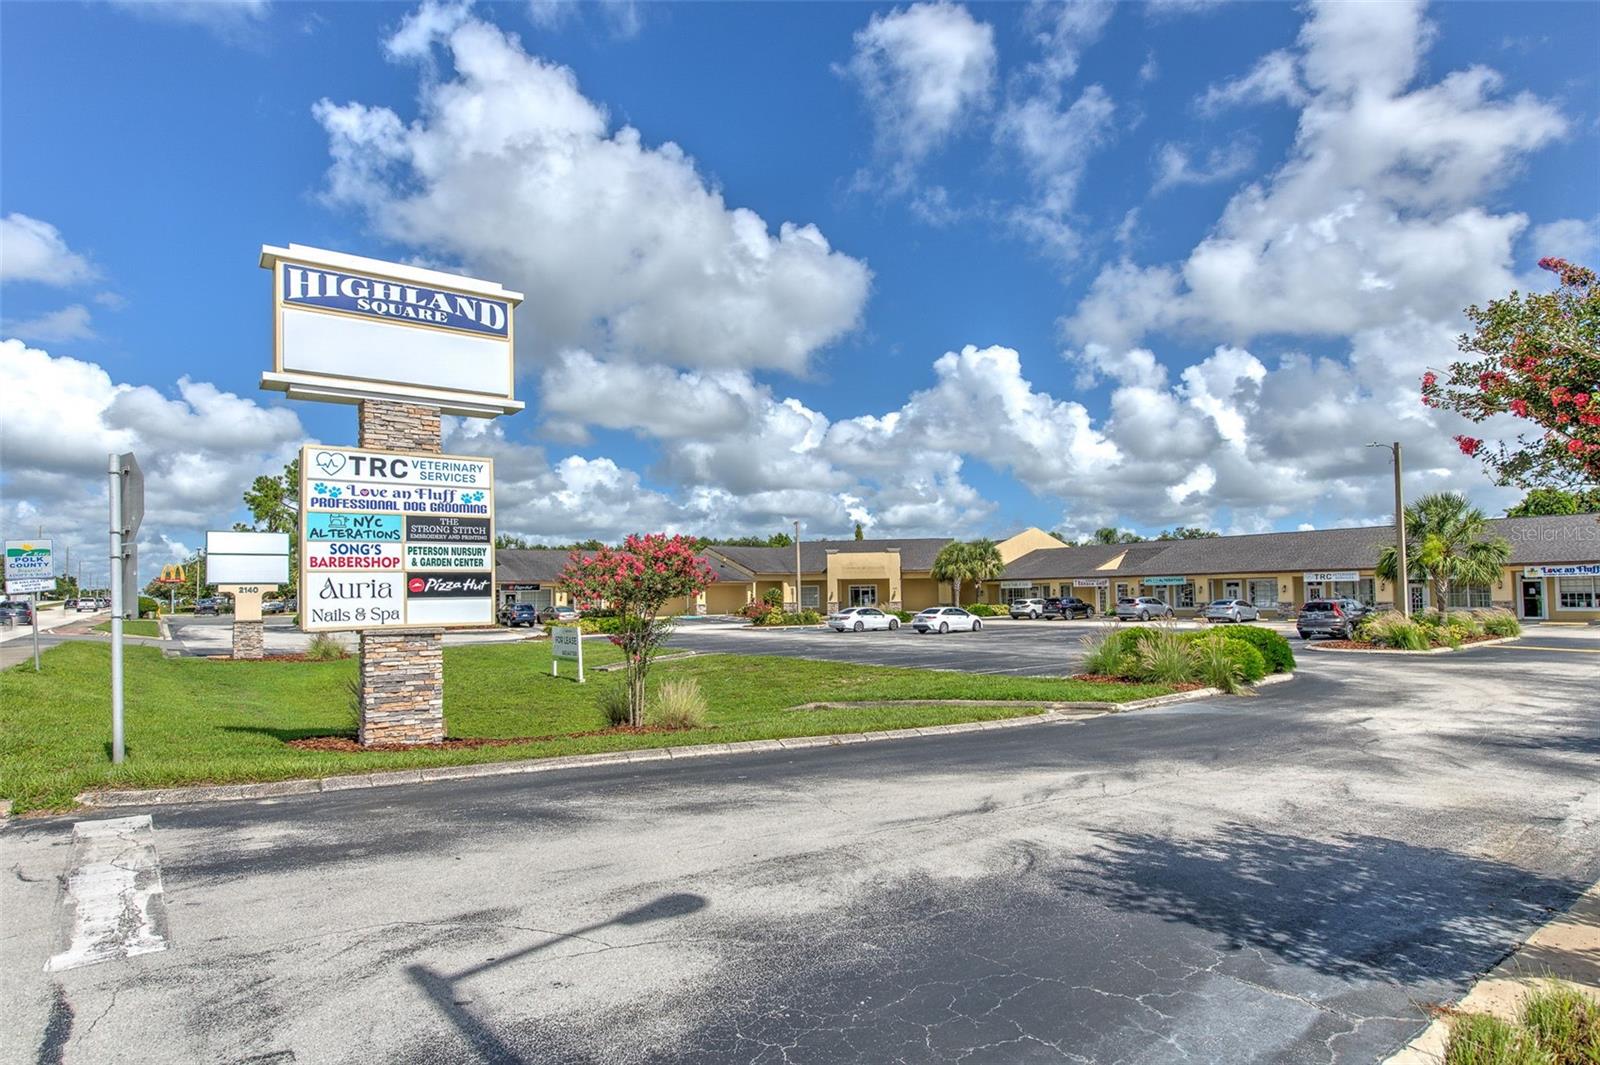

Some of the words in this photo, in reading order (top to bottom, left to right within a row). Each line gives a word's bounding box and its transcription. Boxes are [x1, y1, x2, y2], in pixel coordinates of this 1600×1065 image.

[287, 267, 505, 330] HIGHLAND
[357, 299, 449, 323] SQUARE
[349, 455, 408, 478] TRC
[411, 460, 484, 473] VETERINARY
[419, 471, 476, 483] SERVICES
[346, 484, 388, 498] Love
[392, 488, 412, 500] an
[414, 487, 458, 503] Fluff
[310, 497, 400, 511] PROFESSIONAL
[403, 501, 426, 512] DOG
[429, 502, 488, 514] GROOMING
[353, 515, 383, 528] NYC
[440, 517, 460, 526] THE
[309, 527, 401, 540] ALTERATIONS
[410, 525, 450, 534] STRONG
[452, 526, 486, 535] STITCH
[407, 546, 449, 556] PETERSON
[450, 547, 487, 557] NURSURY
[309, 556, 400, 568] BARBERSHOP
[411, 557, 418, 567] &
[419, 557, 451, 567] GARDEN
[453, 558, 484, 567] CENTER
[1541, 566, 1563, 574] Love
[319, 577, 393, 600] Auria
[424, 578, 462, 592] Pizza
[461, 579, 490, 592] Hut
[312, 608, 351, 622] Nails
[355, 607, 367, 621] &
[370, 607, 400, 624] Spa
